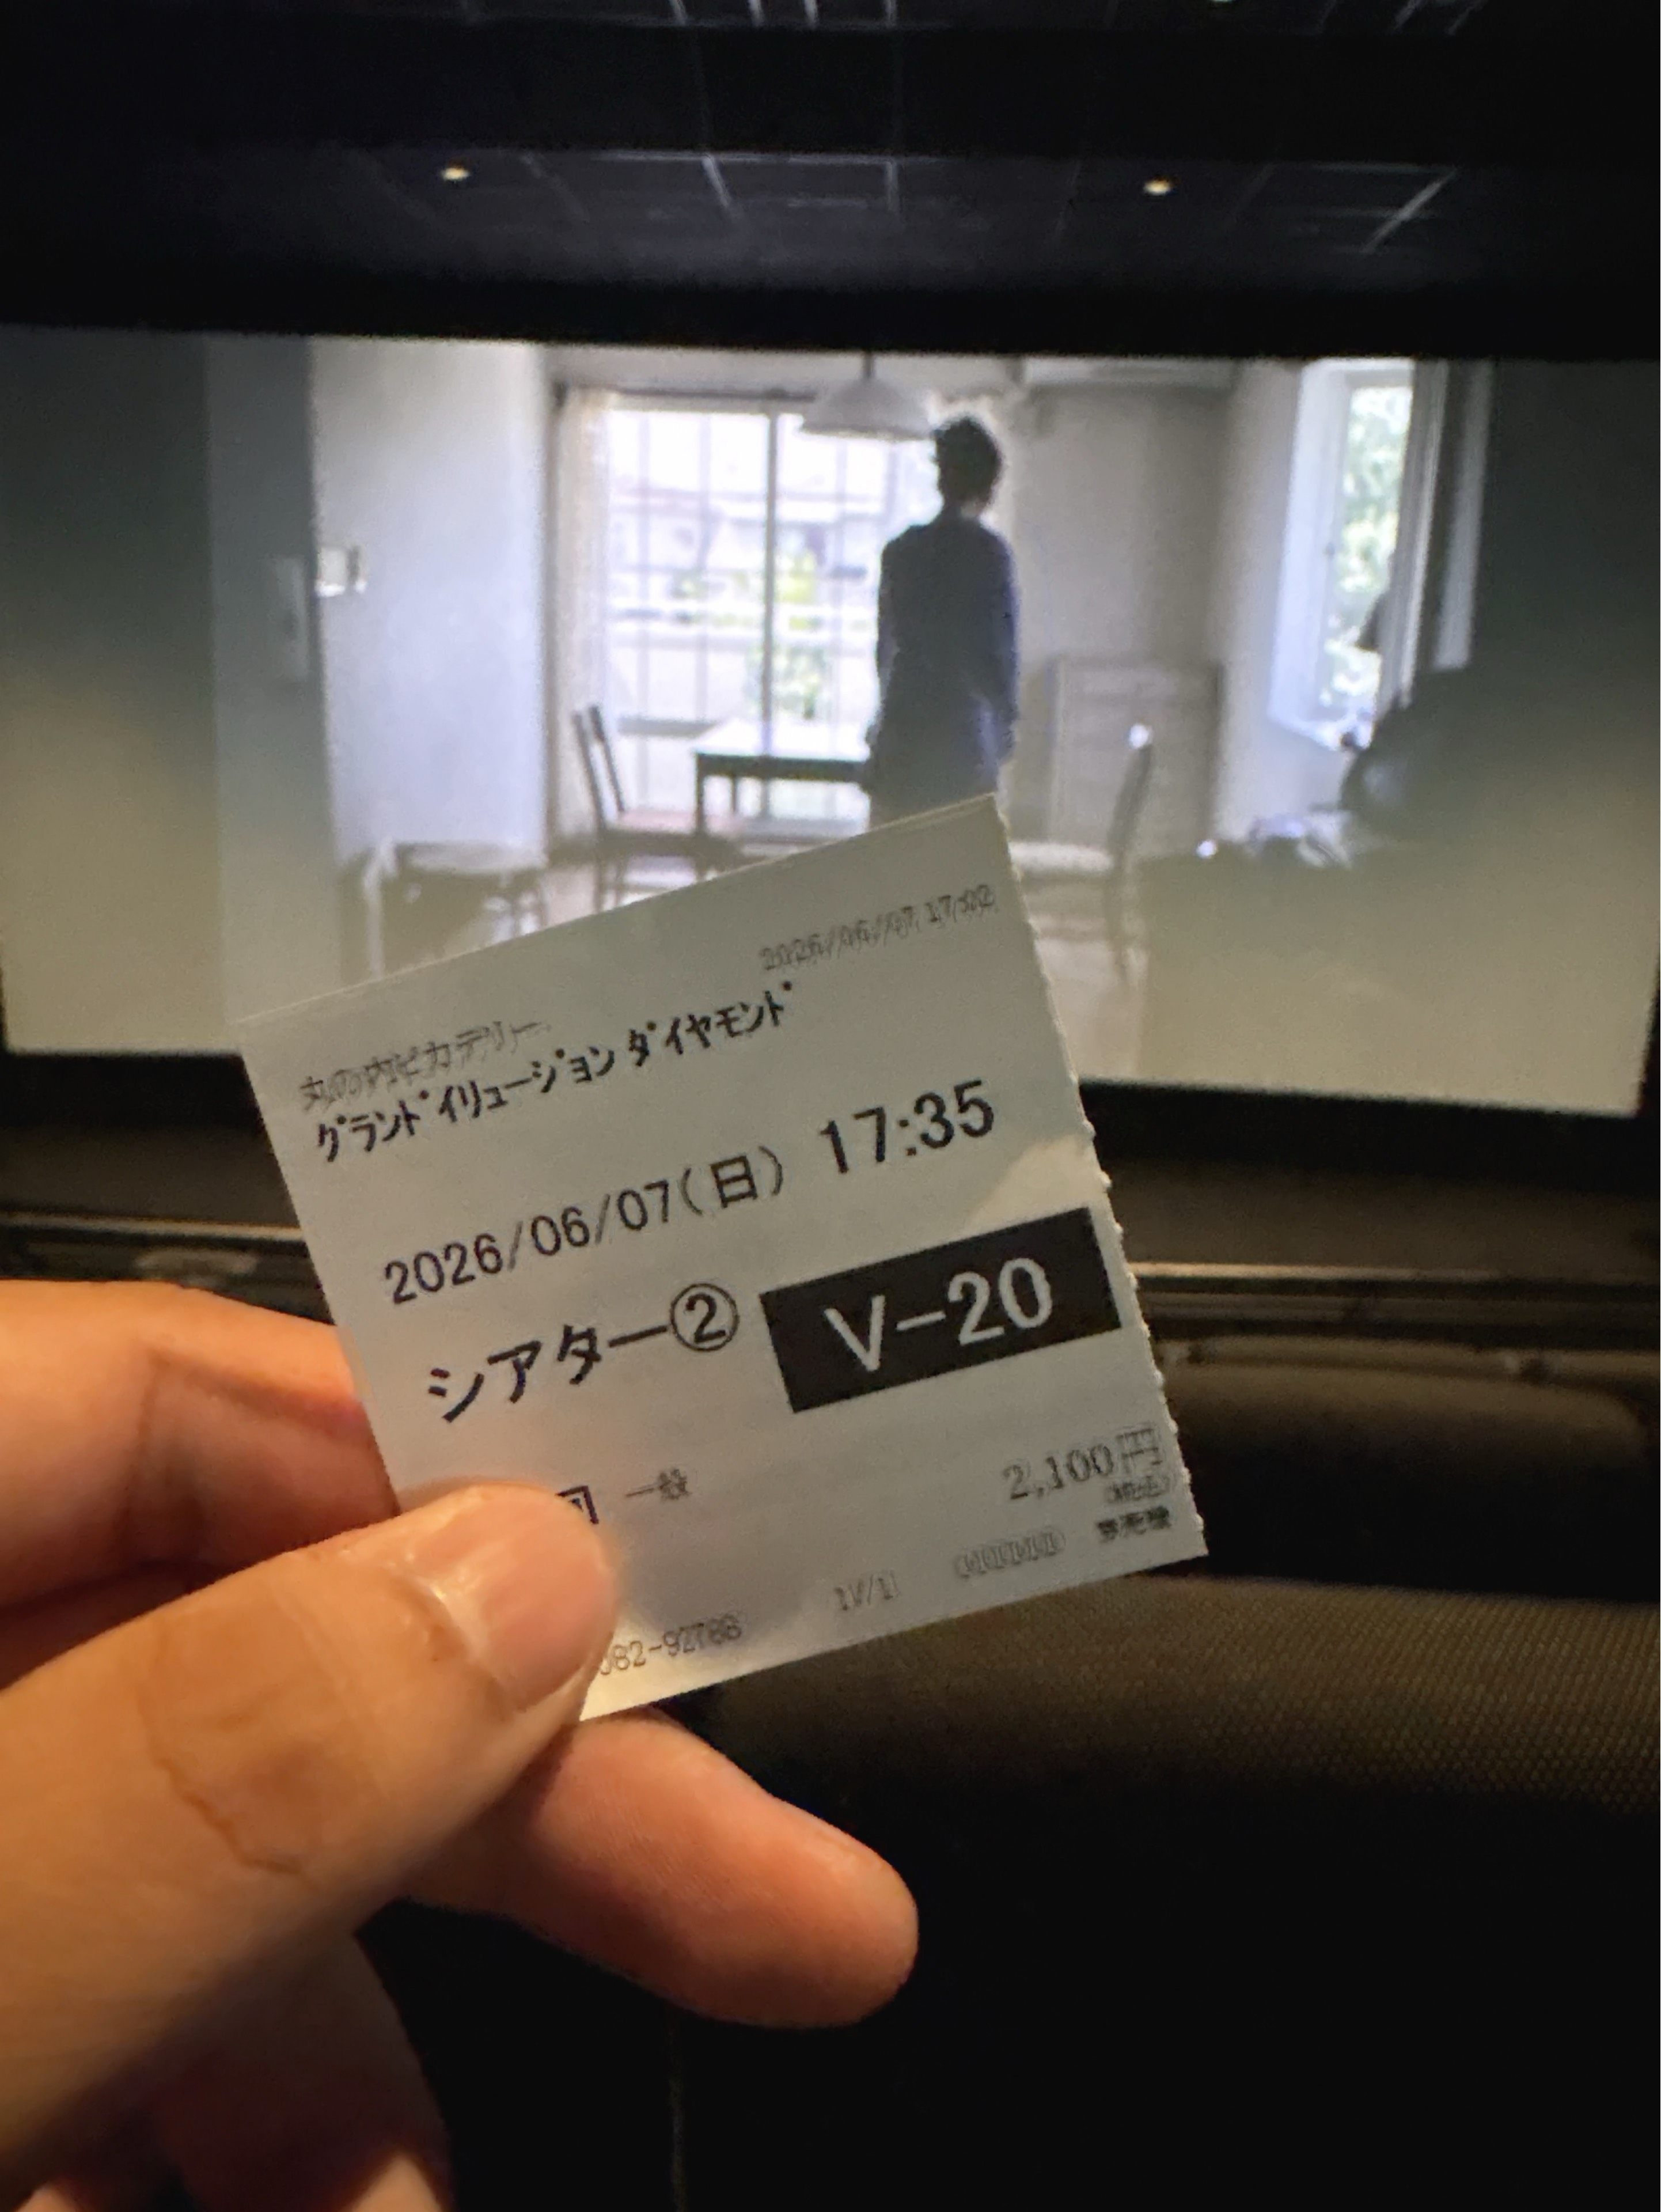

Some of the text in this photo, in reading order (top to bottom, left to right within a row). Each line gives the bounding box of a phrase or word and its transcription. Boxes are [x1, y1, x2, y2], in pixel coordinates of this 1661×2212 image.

[819, 1080, 995, 1175] 17:35
[824, 1257, 1052, 1372] V-20
[1003, 1423, 1163, 1500] 2,100円
